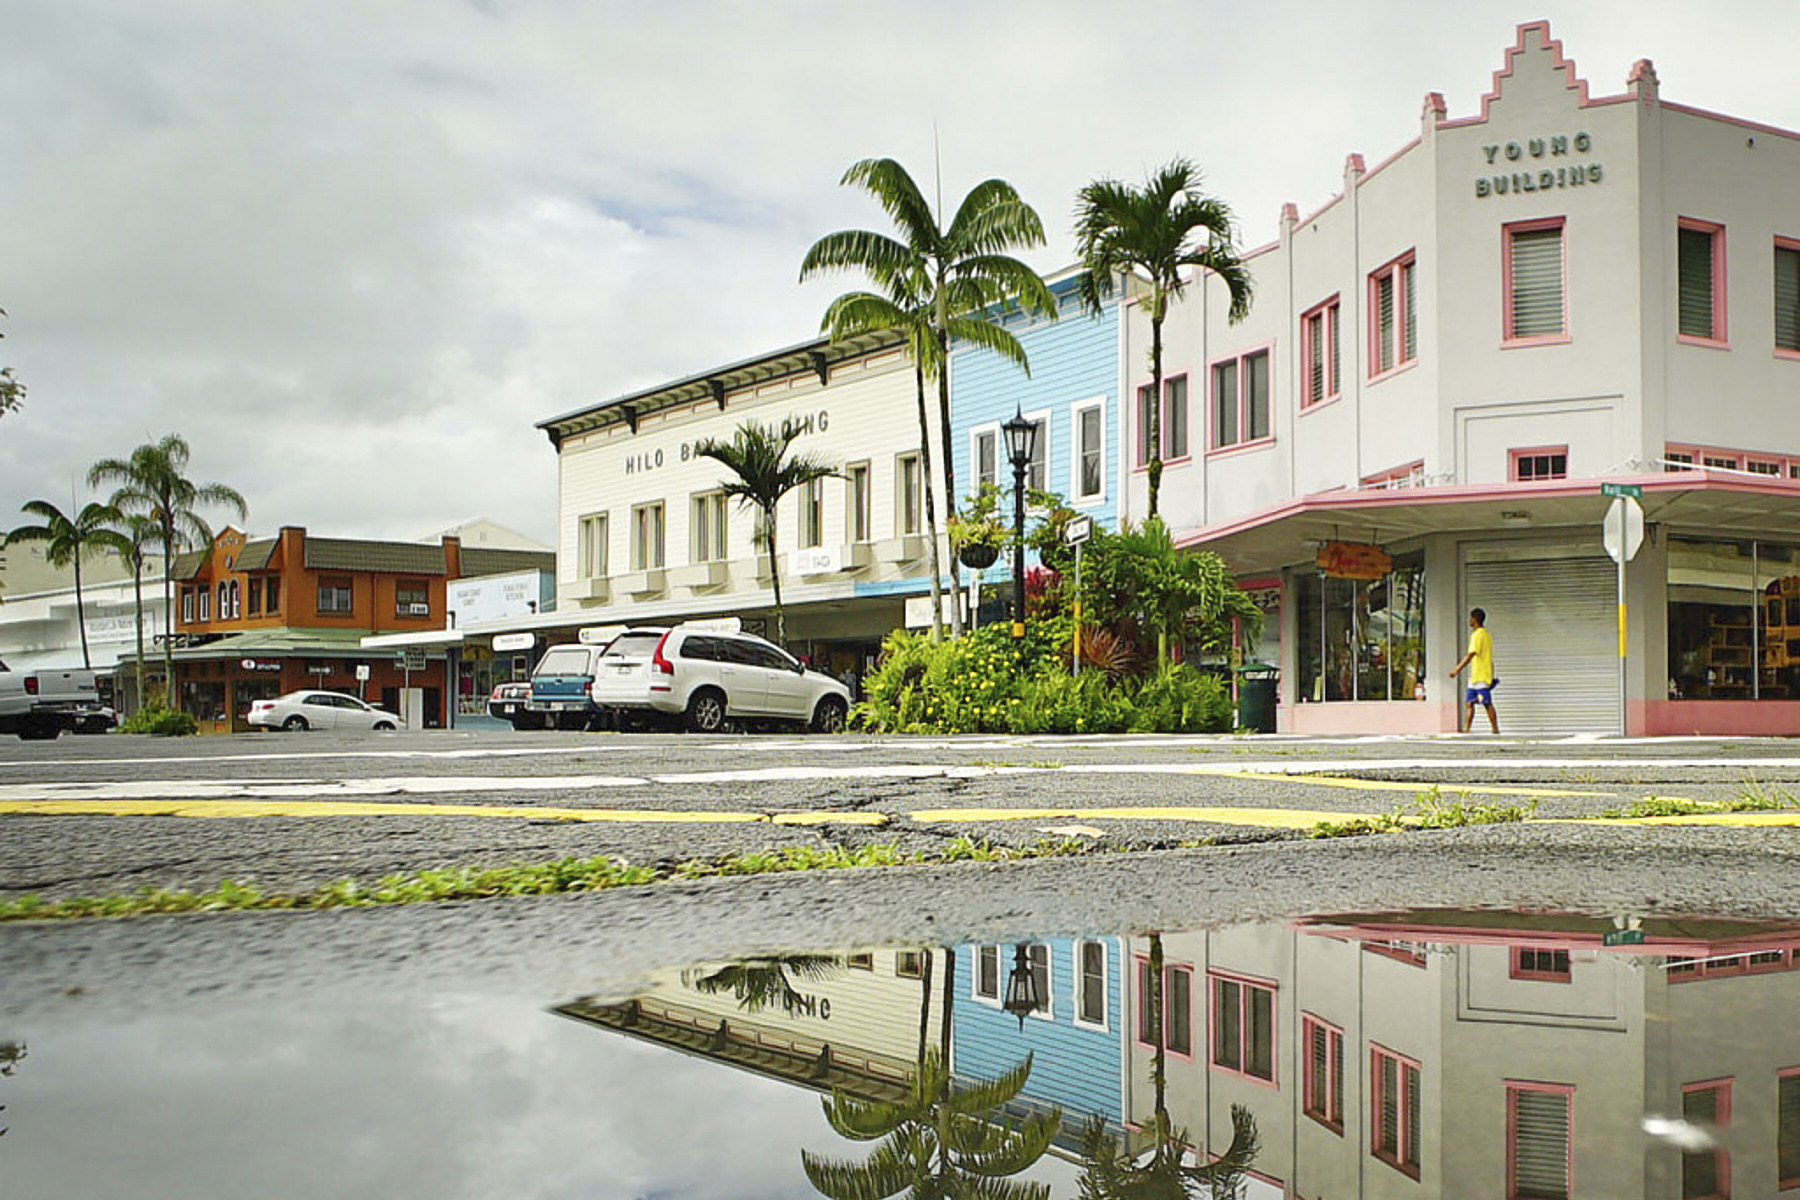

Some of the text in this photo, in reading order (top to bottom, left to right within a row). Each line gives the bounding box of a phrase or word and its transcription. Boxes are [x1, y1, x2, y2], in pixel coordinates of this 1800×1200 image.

[1482, 132, 1591, 165] YOUNG
[1475, 162, 1604, 198] BUILDING
[625, 448, 664, 474] HILO
